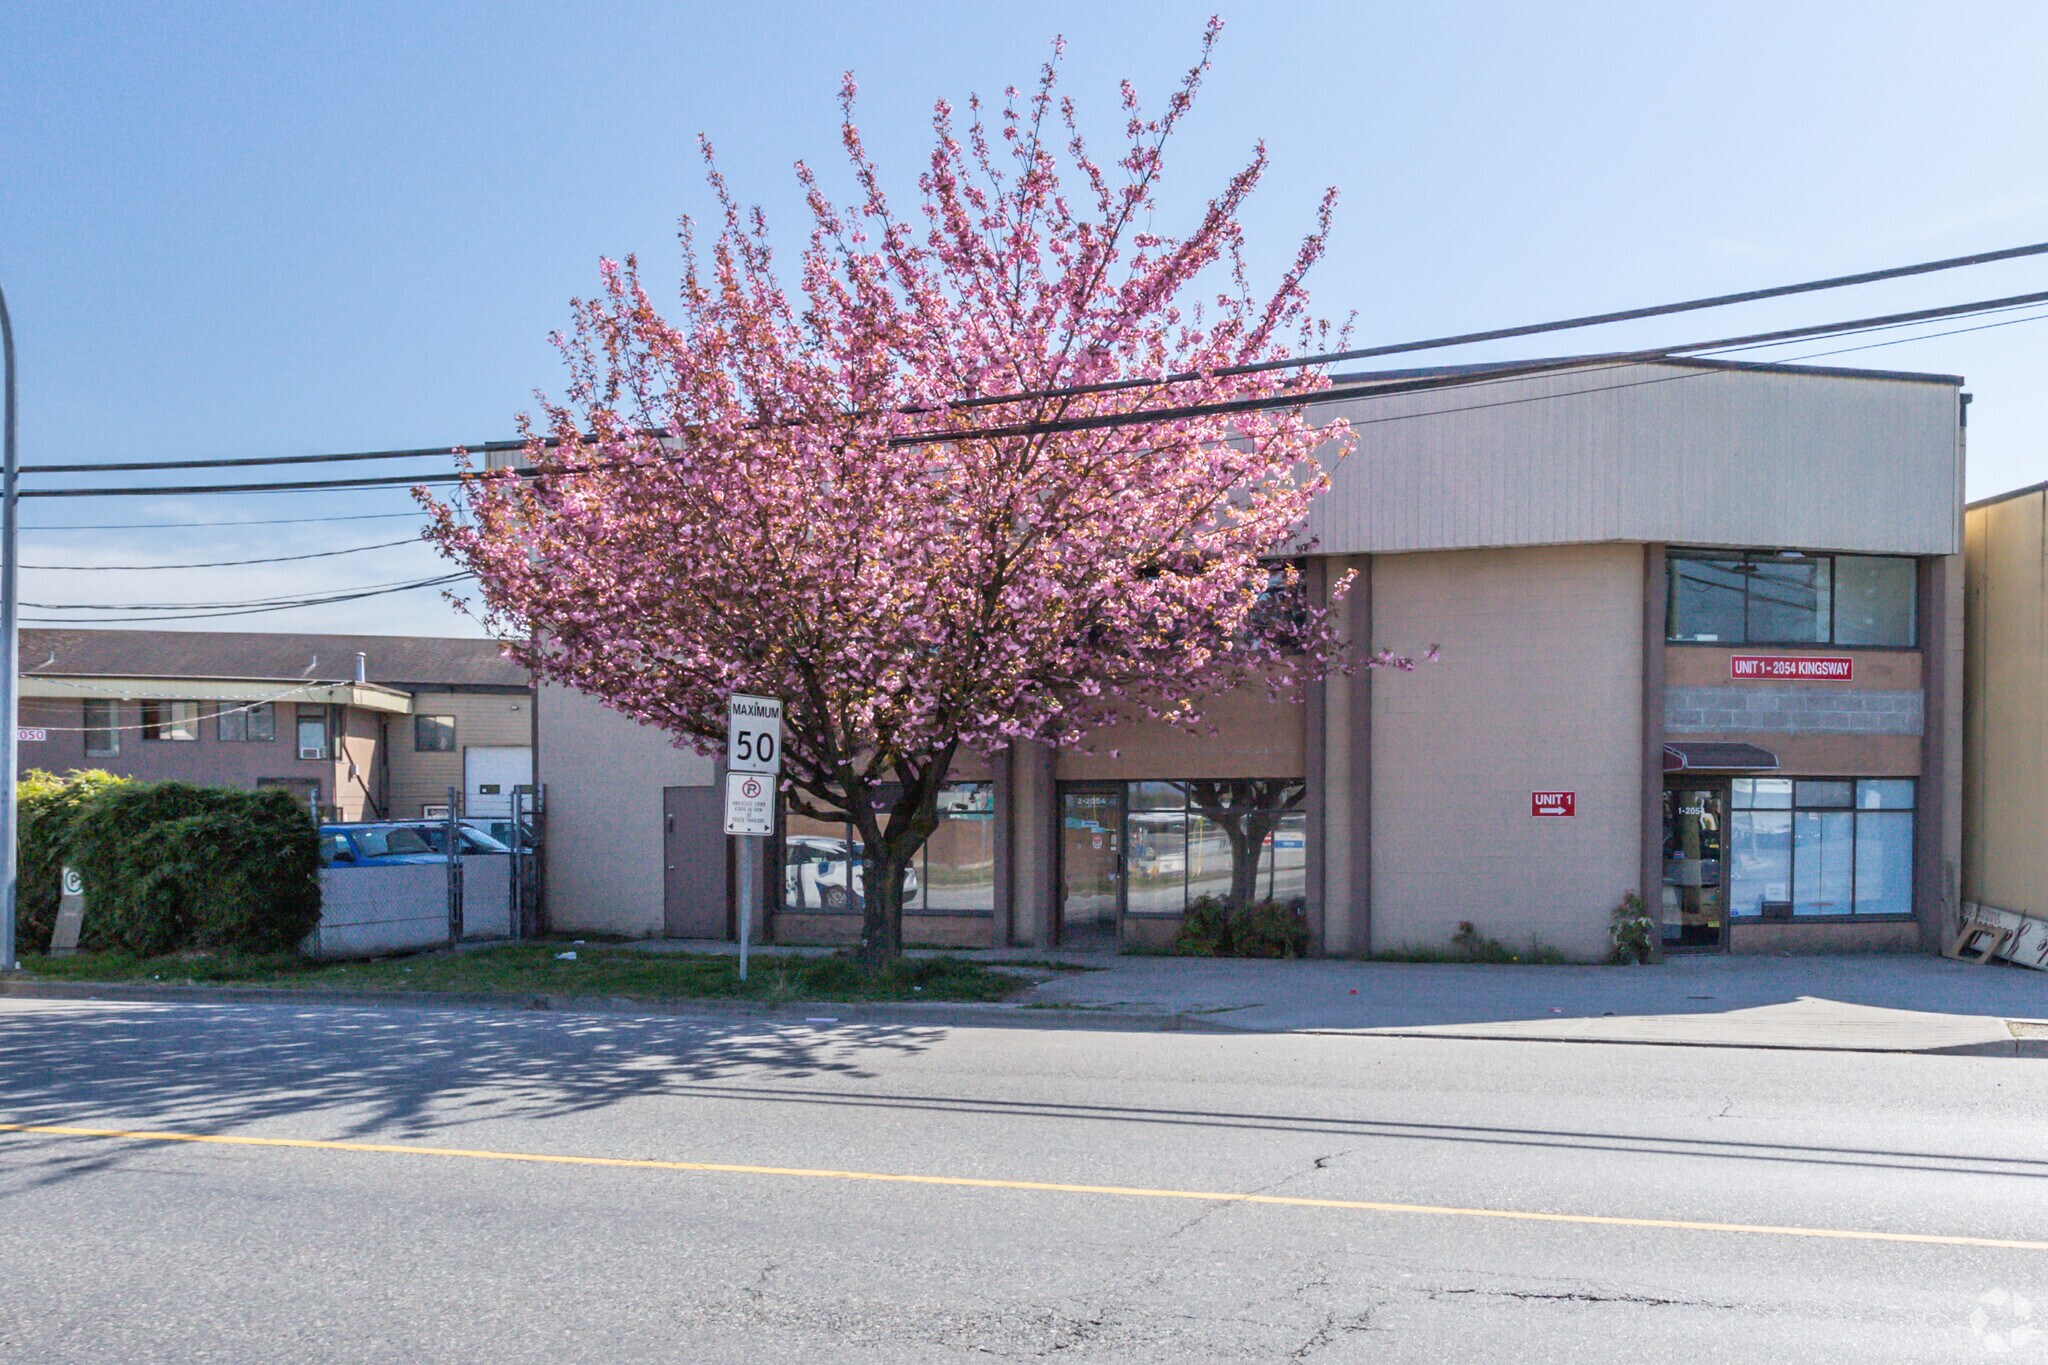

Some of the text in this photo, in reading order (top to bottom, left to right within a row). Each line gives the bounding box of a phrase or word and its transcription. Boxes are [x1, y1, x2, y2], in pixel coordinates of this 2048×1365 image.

[1735, 660, 1758, 674] UNIT
[1798, 661, 1849, 675] KINGSWAY
[732, 703, 779, 719] MAXIMUM
[17, 730, 44, 740] 050
[737, 730, 774, 763] 50
[1535, 794, 1572, 805] UNIT 1
